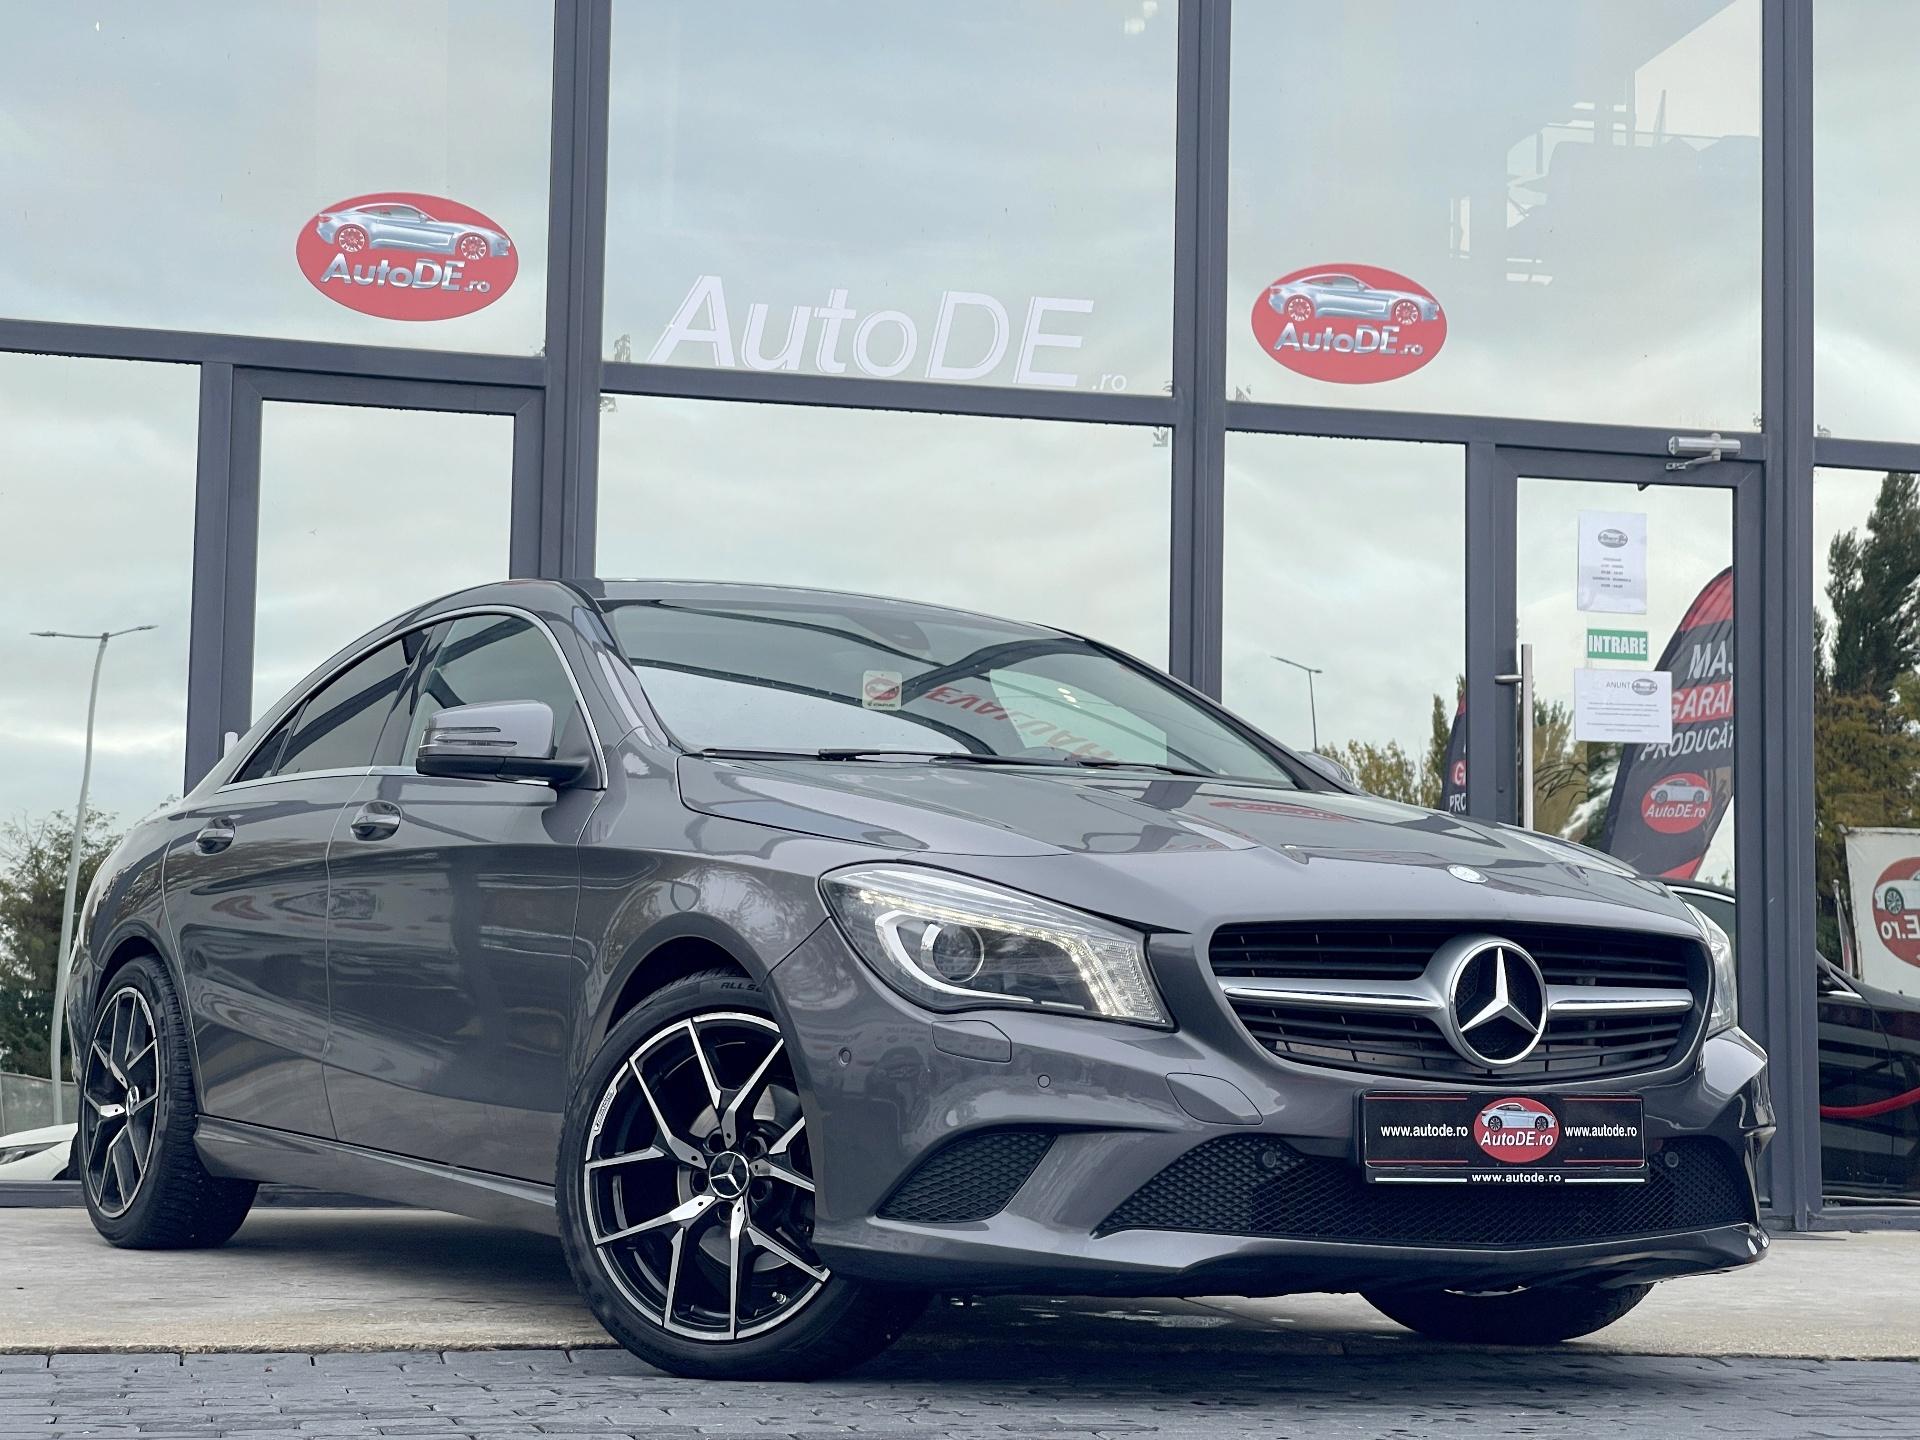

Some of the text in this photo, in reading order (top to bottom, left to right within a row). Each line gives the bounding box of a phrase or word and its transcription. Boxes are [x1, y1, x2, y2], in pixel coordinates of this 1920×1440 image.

[1588, 635, 1647, 655] INTRARE
[1645, 803, 1706, 819] AutoDE.ro
[720, 982, 745, 990] ALL
[1380, 1123, 1469, 1138] www.autode.ro
[1480, 1130, 1554, 1146] AutoDE.ro
[1565, 1123, 1638, 1138] www.autode.ro
[1471, 1172, 1562, 1184] www.autode.ro
